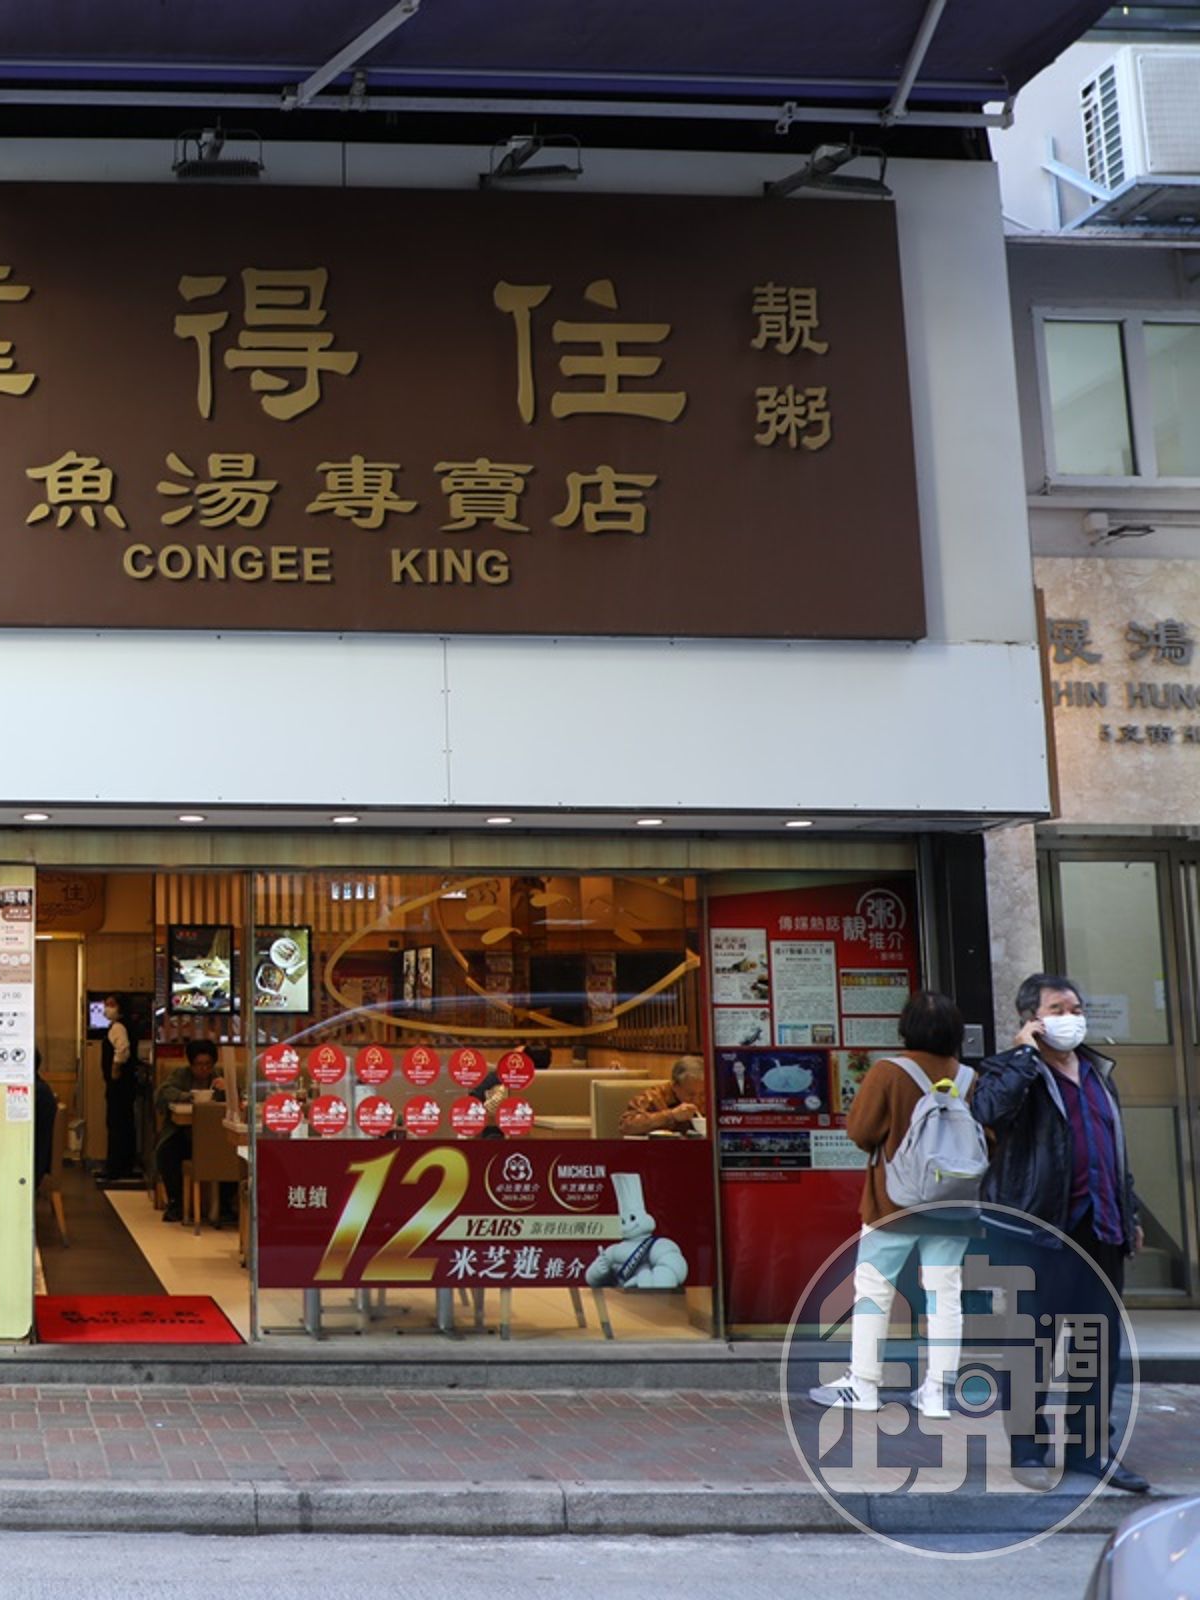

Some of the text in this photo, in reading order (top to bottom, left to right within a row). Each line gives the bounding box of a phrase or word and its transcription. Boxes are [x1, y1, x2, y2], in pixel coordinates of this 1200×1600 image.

[751, 281, 833, 453] 靚粥
[24, 449, 658, 536] 魚湯專賣店
[122, 543, 512, 587] CONGEE KING
[1052, 681, 1108, 708] HIN
[557, 1164, 607, 1179] MICHELIN
[288, 1185, 327, 1209] 連續
[313, 1146, 470, 1281] 12
[465, 1219, 524, 1237] YEARS
